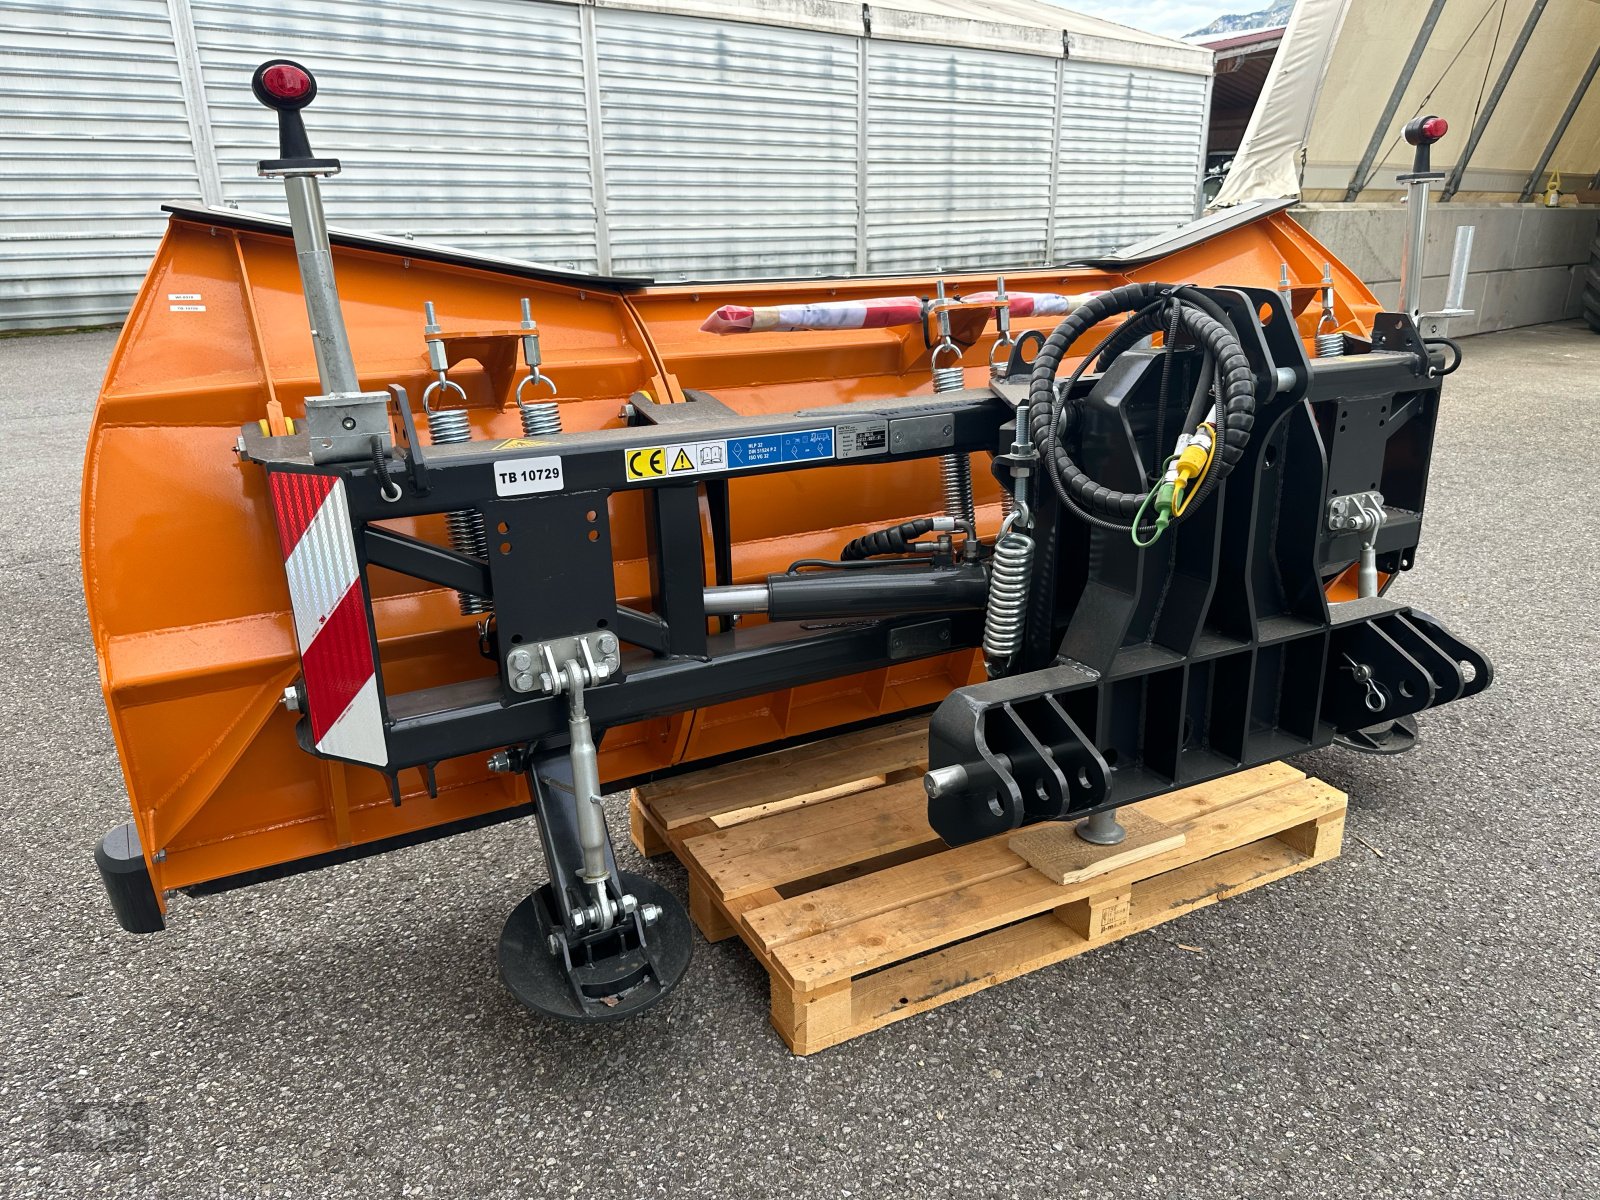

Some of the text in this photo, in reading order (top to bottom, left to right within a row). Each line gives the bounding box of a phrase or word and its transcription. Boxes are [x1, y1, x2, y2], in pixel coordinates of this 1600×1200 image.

[630, 450, 663, 476] CE
[499, 467, 560, 484] TB 10729
